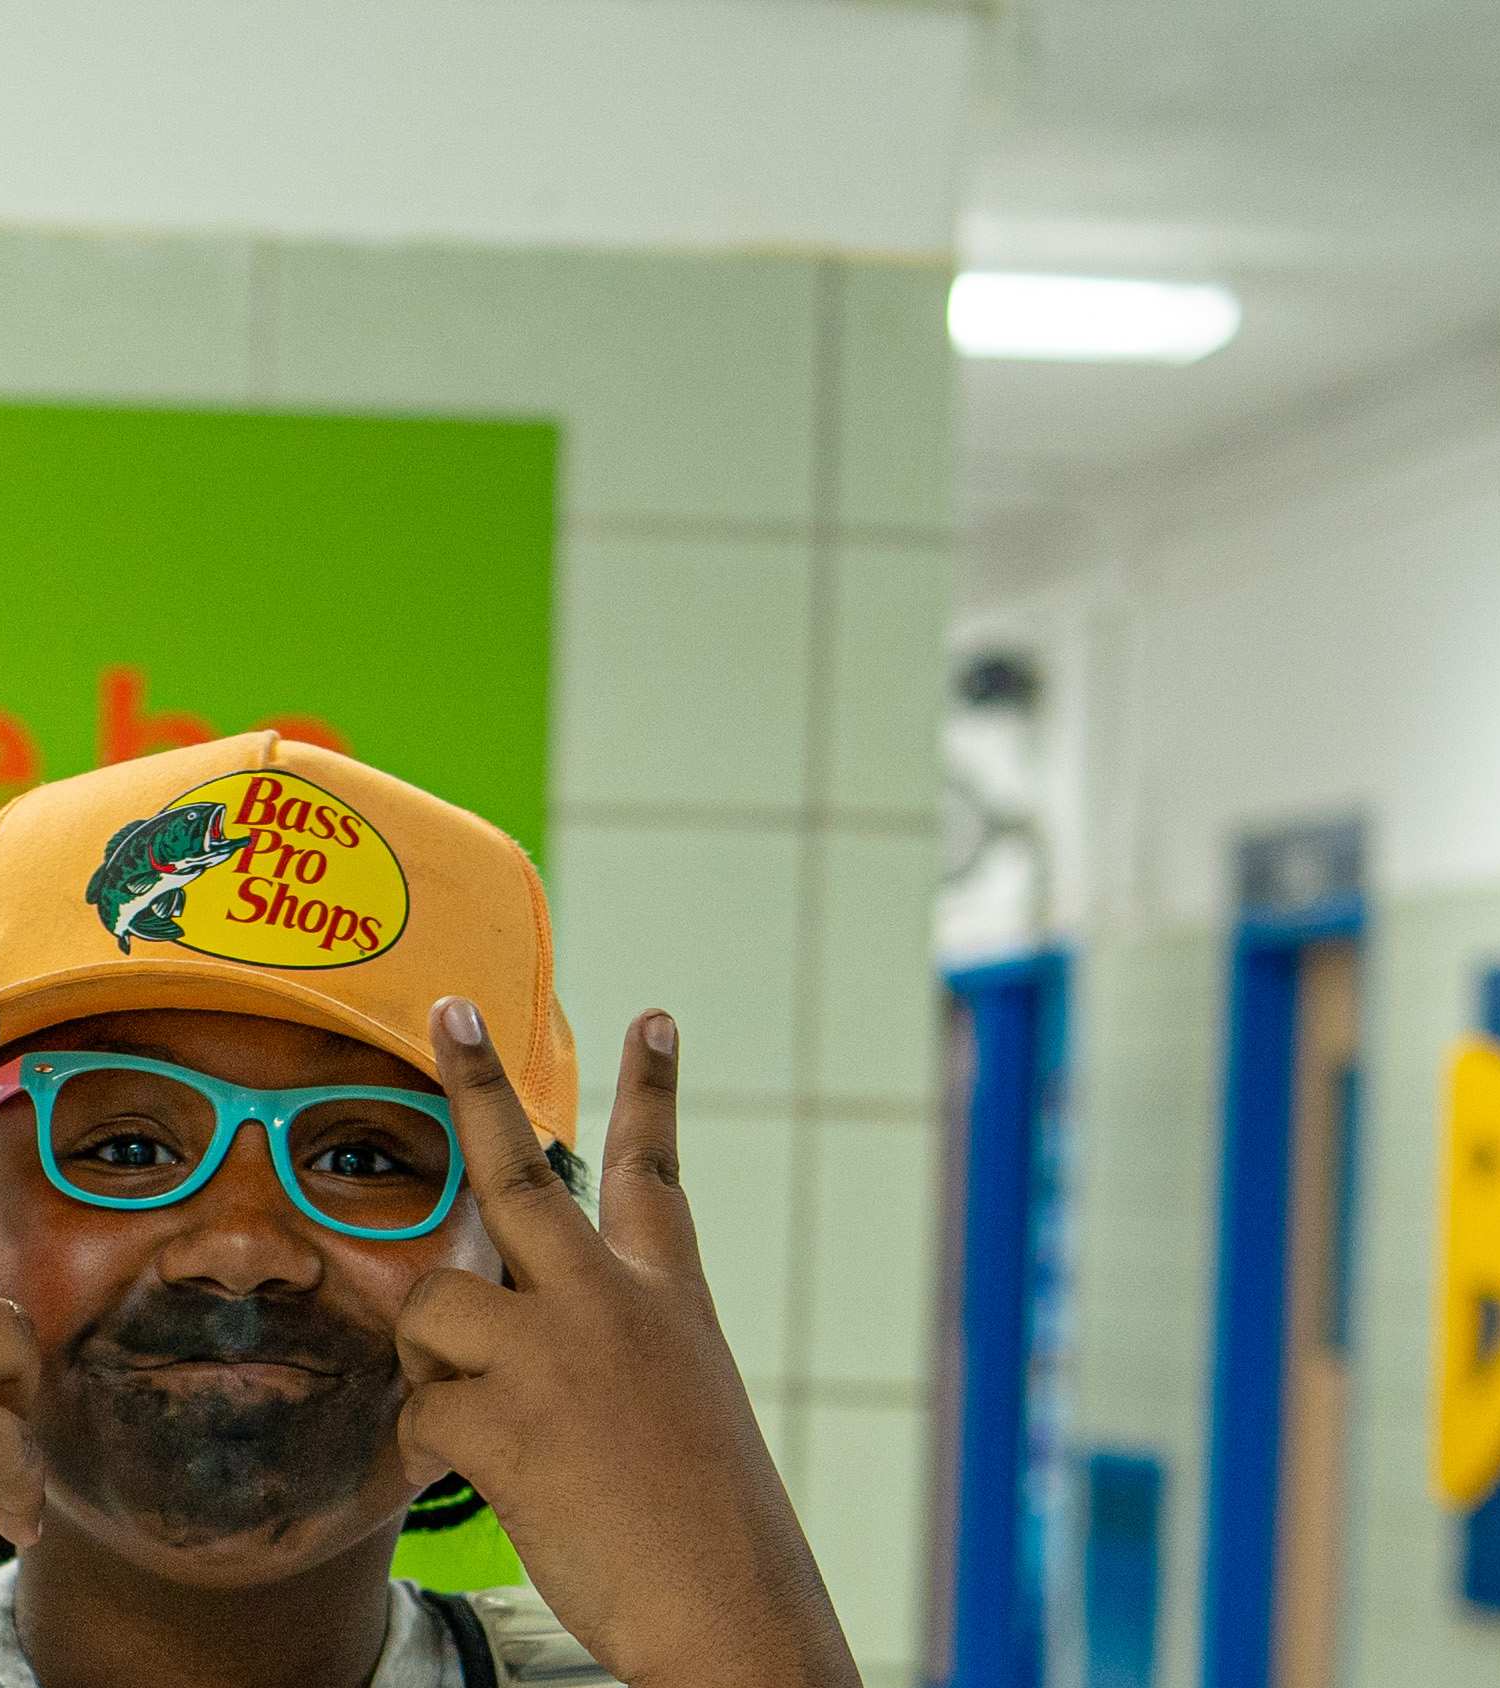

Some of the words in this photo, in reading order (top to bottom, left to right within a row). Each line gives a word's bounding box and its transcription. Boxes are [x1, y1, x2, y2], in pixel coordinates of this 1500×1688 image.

[233, 776, 362, 848] Bass
[232, 827, 328, 884] Pro
[226, 876, 382, 952] Shops
